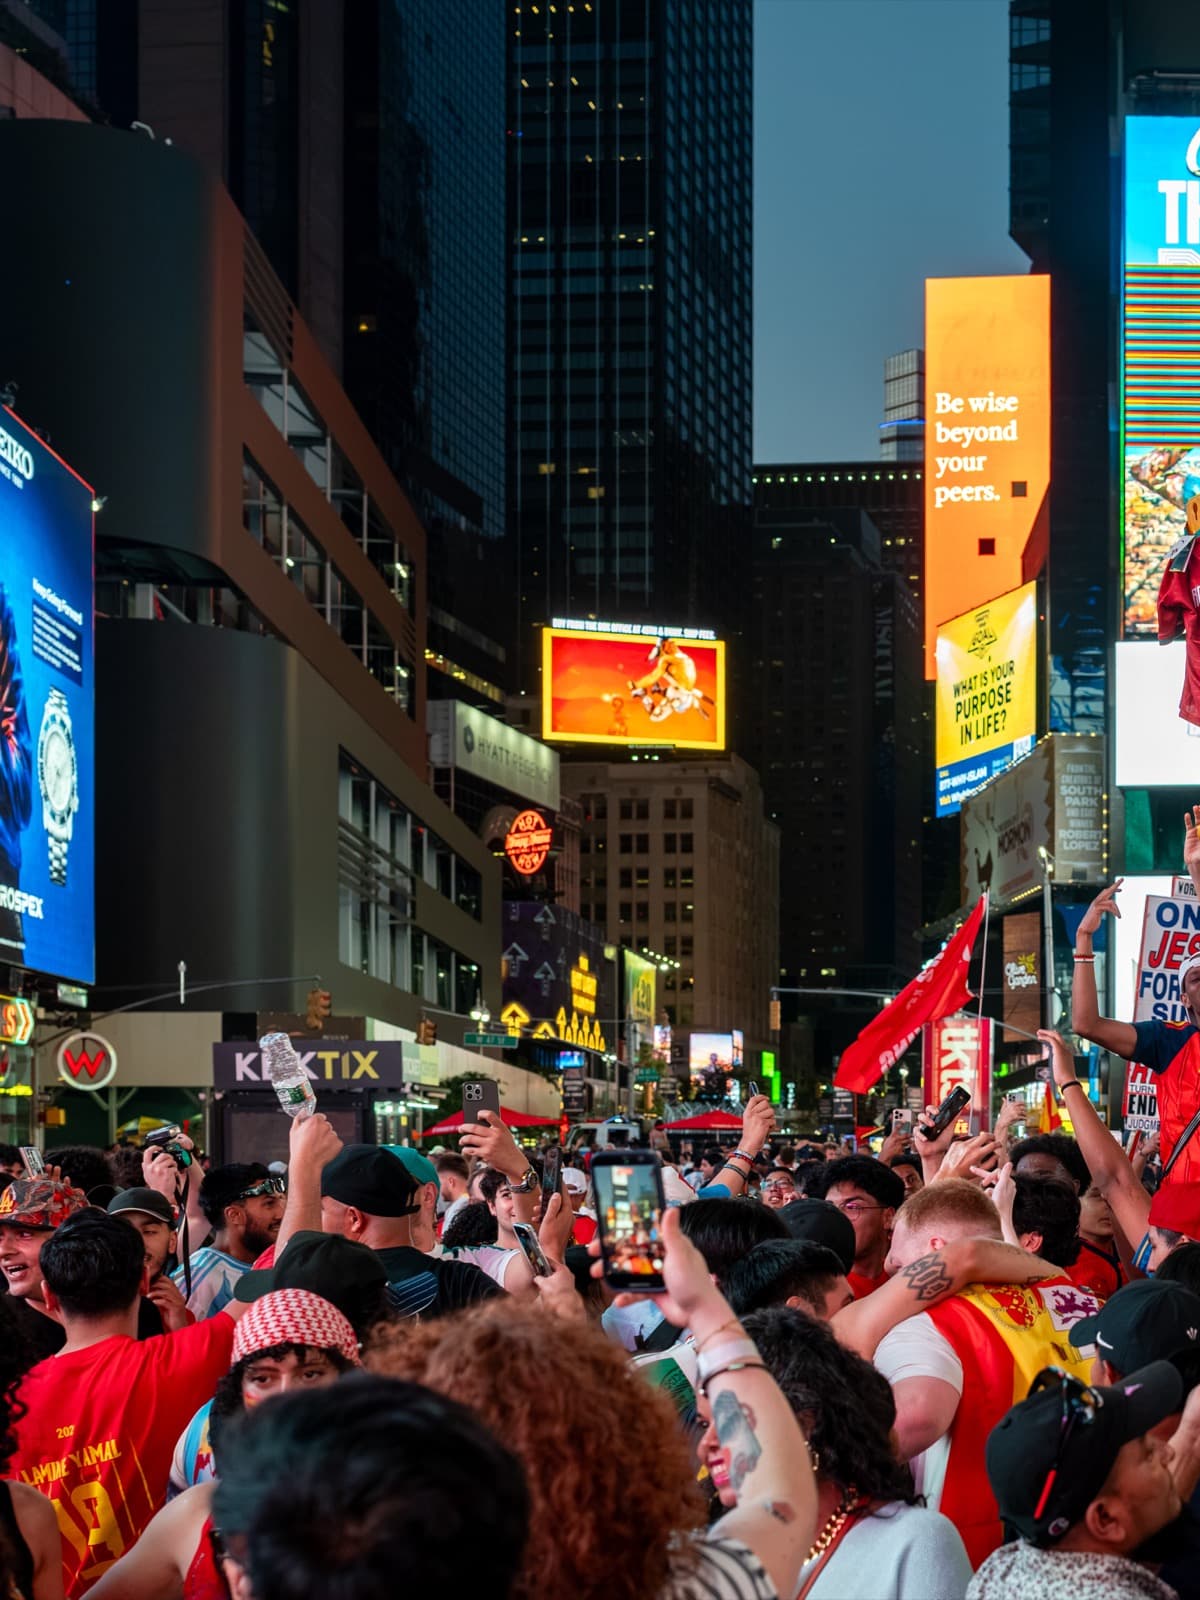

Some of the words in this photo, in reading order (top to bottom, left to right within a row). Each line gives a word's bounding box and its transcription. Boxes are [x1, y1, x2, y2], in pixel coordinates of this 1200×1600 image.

[935, 392, 964, 414] Be
[968, 391, 1019, 413] wise
[935, 419, 1018, 449] beyond
[935, 456, 987, 479] your
[934, 484, 1001, 509] peers.
[953, 674, 978, 699] WHAT
[980, 669, 988, 688] IS
[989, 659, 1015, 684] YOUR
[955, 681, 1012, 722] PURPOSE
[960, 724, 973, 746] IN
[976, 709, 1007, 740] LIFE?
[1129, 1083, 1155, 1095] TURN
[1128, 1094, 1157, 1117] END
[68, 1439, 122, 1469] YAMAL
